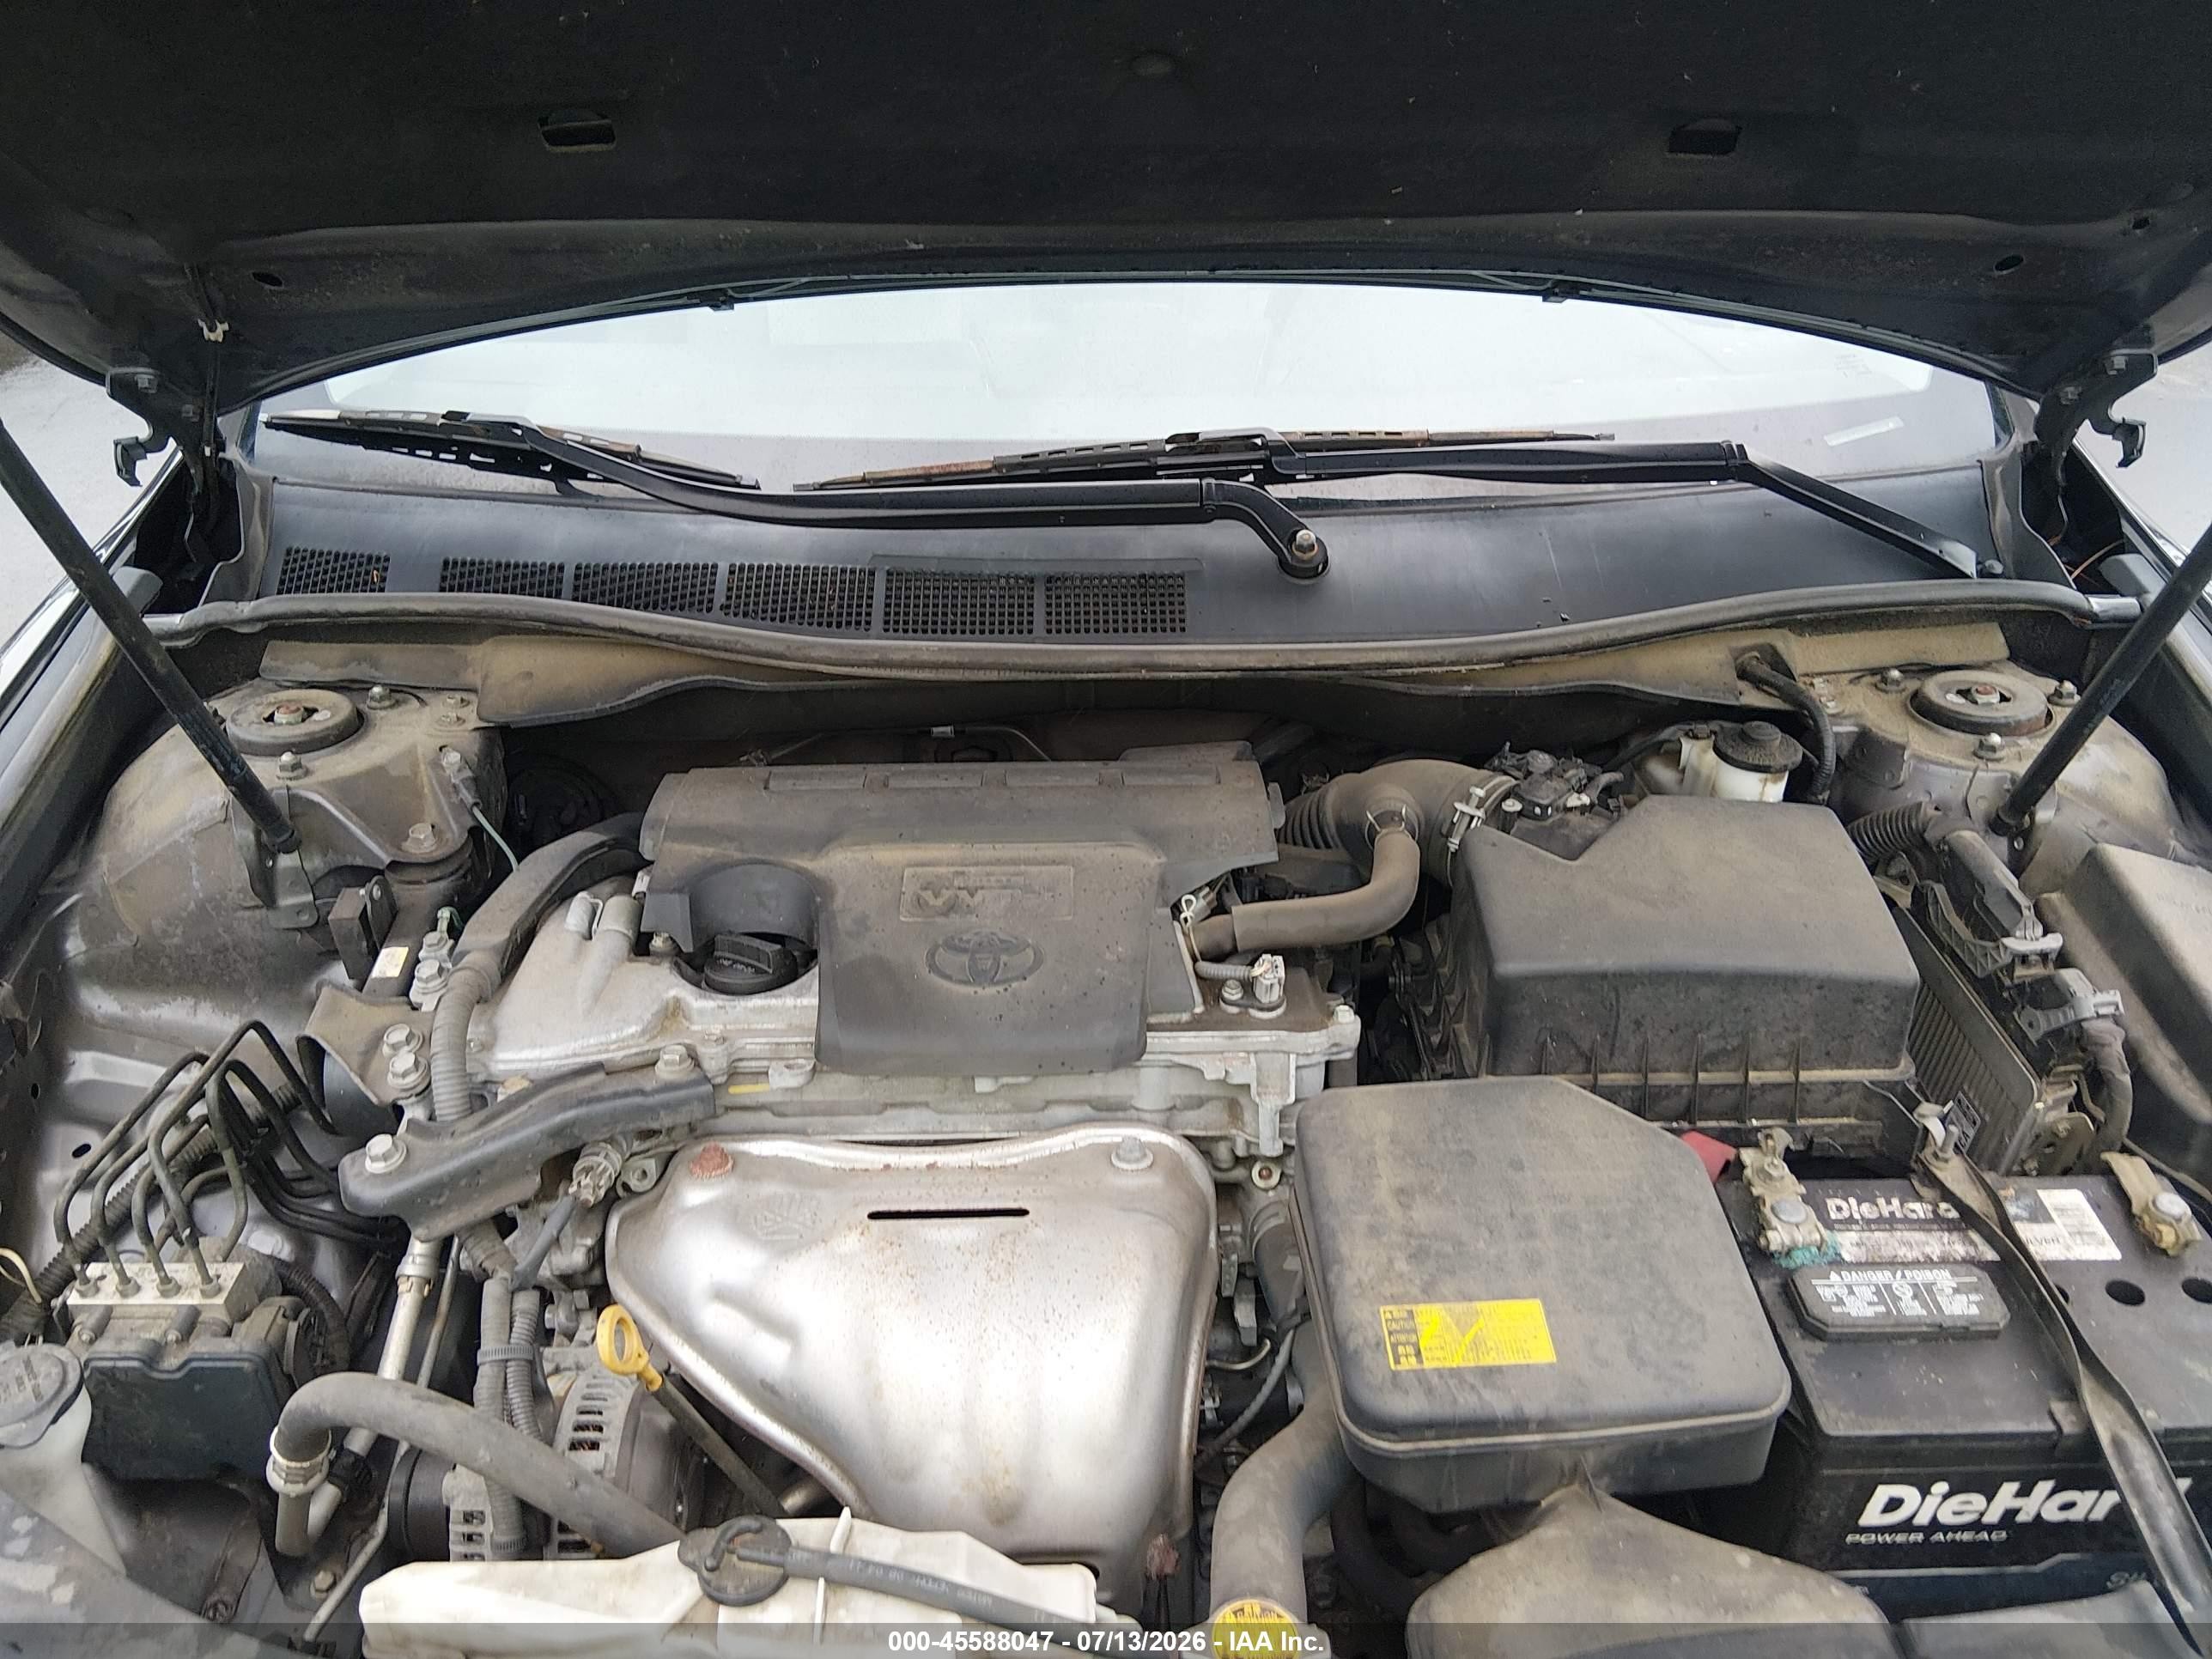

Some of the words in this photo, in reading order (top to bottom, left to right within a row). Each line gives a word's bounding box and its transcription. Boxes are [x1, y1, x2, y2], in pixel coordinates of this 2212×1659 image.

[1841, 1270, 1893, 1282] DANGER
[1905, 1269, 1952, 1282] POISON
[1857, 1479, 2192, 1528] DieHar
[1845, 1531, 1924, 1545] POWER
[1930, 1530, 2008, 1543] AHEAD
